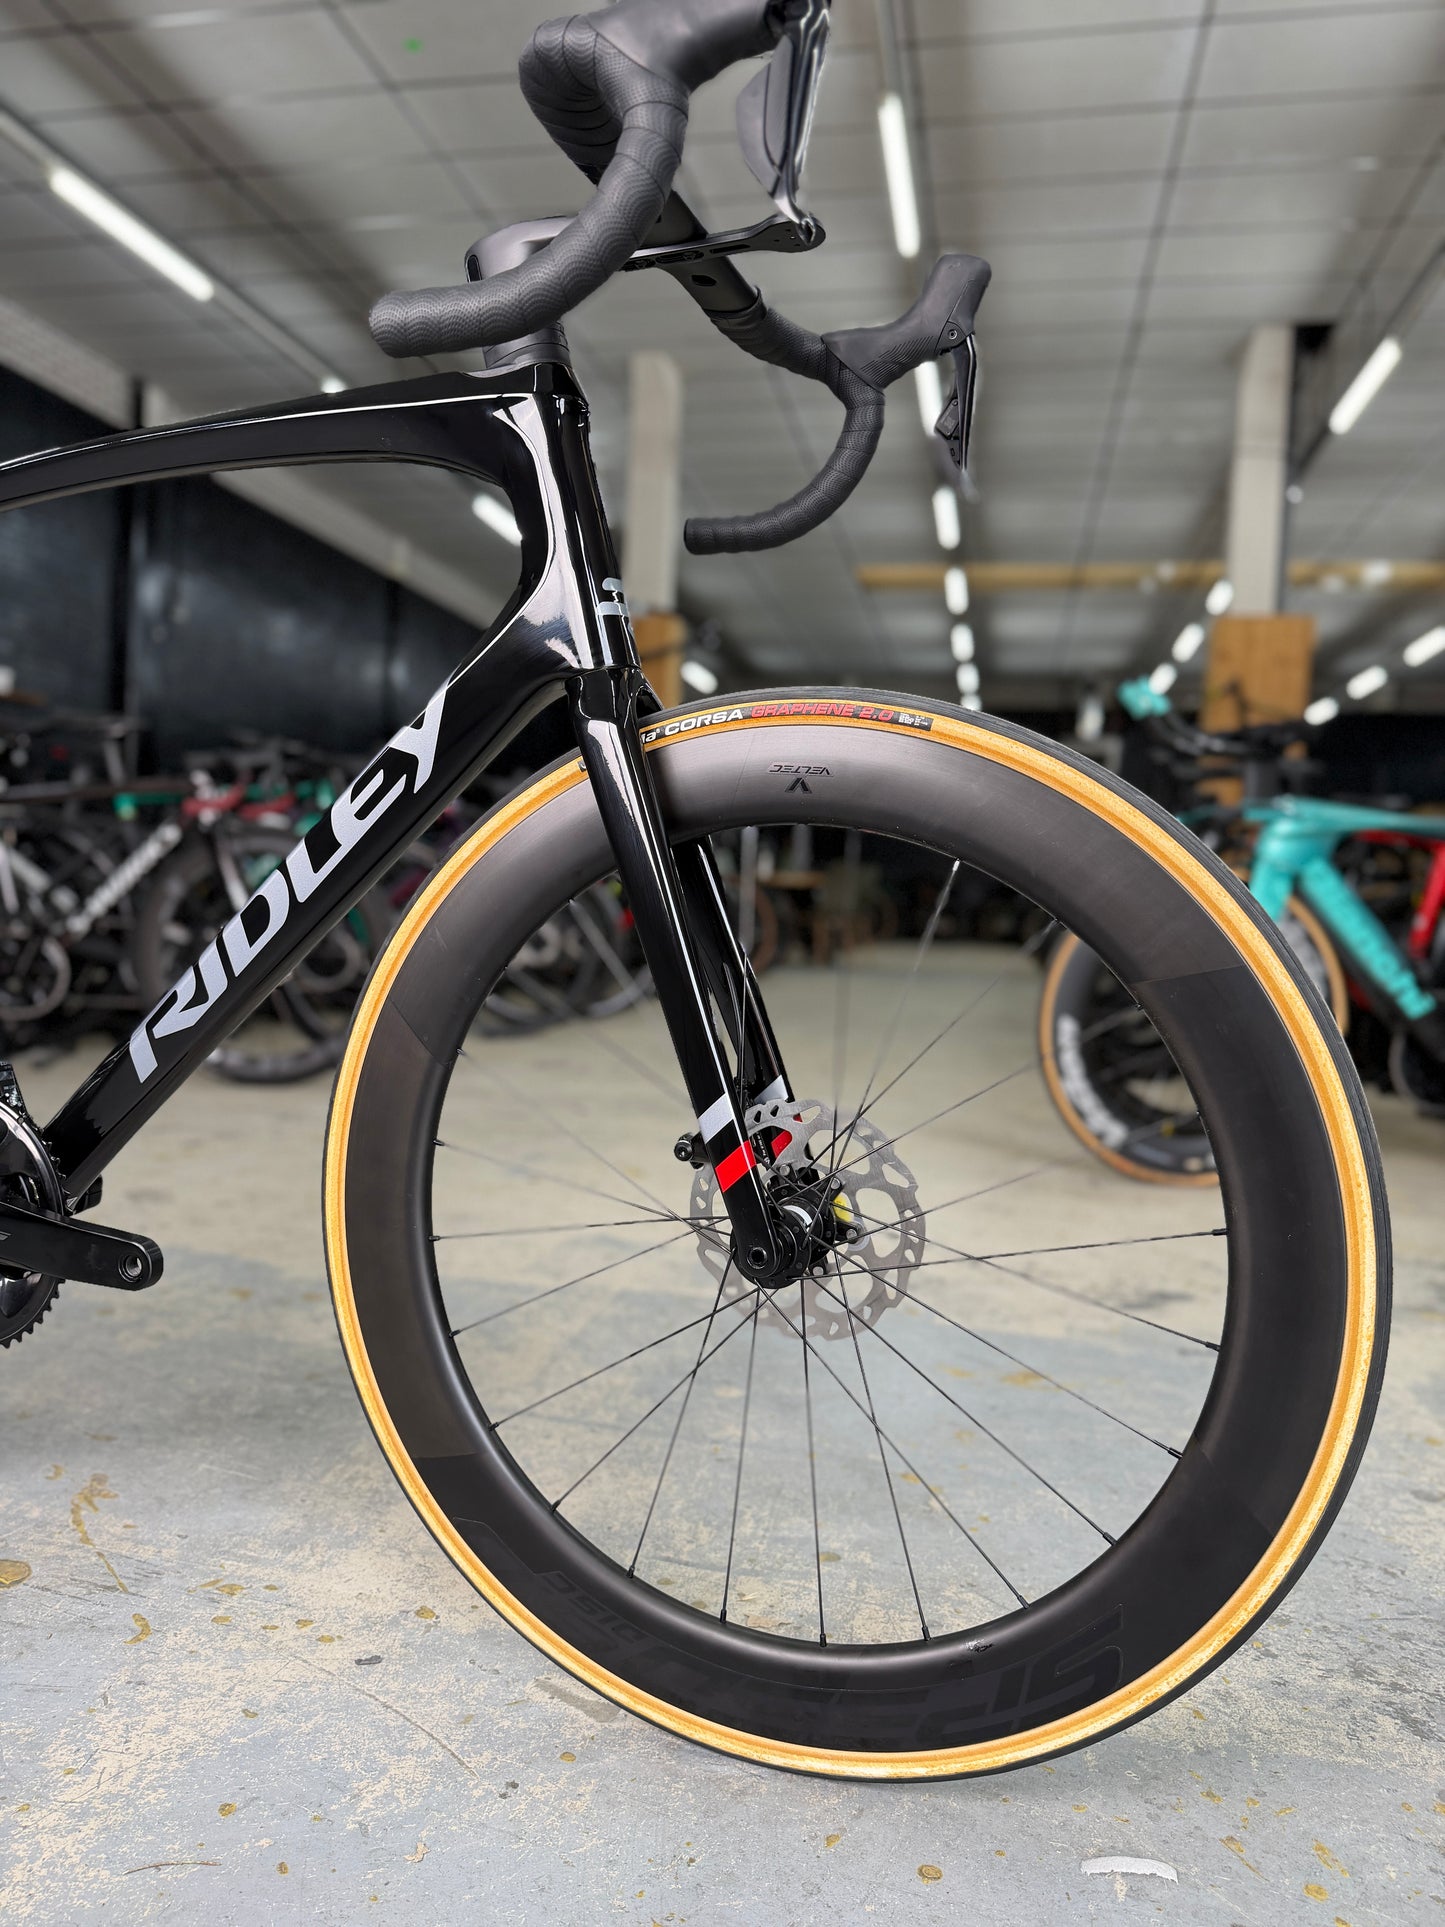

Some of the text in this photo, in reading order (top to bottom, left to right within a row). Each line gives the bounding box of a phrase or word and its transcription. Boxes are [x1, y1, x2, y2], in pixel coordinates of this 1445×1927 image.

[664, 708, 744, 736] CORSA
[751, 702, 858, 718] GRAPHENE
[858, 706, 894, 721] 2.0
[769, 764, 831, 775] VELTEC
[129, 666, 459, 1083] RIDLEY
